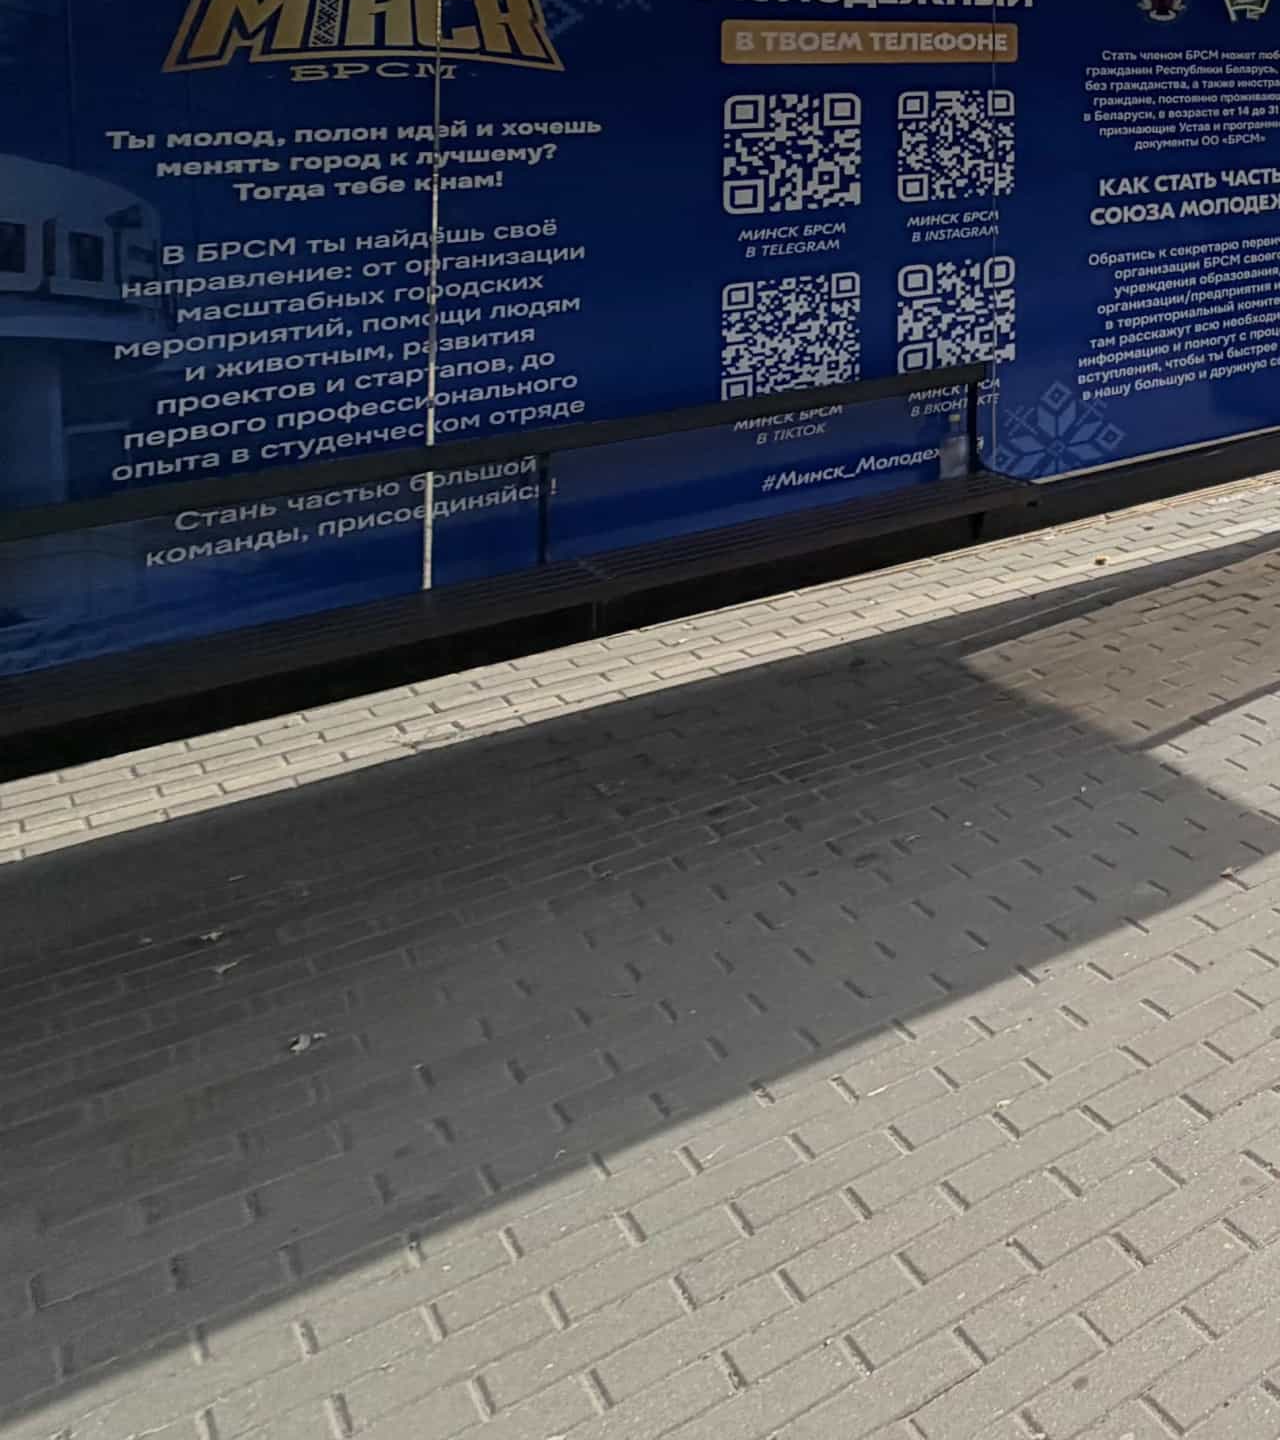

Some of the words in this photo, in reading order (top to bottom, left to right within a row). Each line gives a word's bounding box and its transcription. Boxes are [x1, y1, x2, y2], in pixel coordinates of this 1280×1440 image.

[735, 31, 754, 52] В
[760, 31, 863, 52] ТВОЕМ
[869, 31, 1008, 52] ТЕЛЕФОНЕ
[1102, 50, 1137, 61] Стать
[1139, 51, 1183, 60] членом
[1185, 50, 1218, 60] БРСМ
[290, 62, 456, 82] БРСМ
[1085, 65, 1153, 77] гражданин
[1155, 65, 1223, 77] Республики
[1085, 79, 1107, 91] без
[1110, 80, 1189, 92] гражданства,
[1094, 110, 1157, 123] Беларуси,
[1168, 108, 1220, 120] возрасте
[1222, 108, 1235, 116] от
[1238, 106, 1250, 116] 14
[1251, 107, 1265, 117] до
[1267, 105, 1279, 115] 31
[1179, 122, 1211, 133] Устав
[105, 131, 155, 149] Ты
[166, 130, 286, 148] молод,
[295, 126, 388, 143] полон
[397, 120, 467, 141] идей
[476, 123, 493, 137] и
[501, 120, 602, 136] хочешь
[1134, 137, 1199, 151] документы
[1201, 135, 1219, 146] ОО
[1222, 133, 1266, 145] «БРСМ»
[156, 158, 280, 177] менять
[289, 153, 381, 173] город
[390, 152, 408, 166] к
[416, 143, 557, 168] лучшему?
[232, 182, 326, 201] Тогда
[334, 175, 406, 196] тебе
[414, 178, 431, 191] к
[440, 171, 503, 190] нам!
[1099, 176, 1150, 197] КАК
[1154, 171, 1217, 192] СТАТЬ
[907, 213, 959, 227] МИНСК
[1089, 203, 1176, 226] СОЮЗА
[162, 245, 185, 264] В
[197, 237, 296, 263] БРСМ
[306, 238, 345, 254] ты
[356, 227, 485, 250] найдёшь
[494, 218, 558, 240] своё
[738, 225, 799, 242] МИНСК
[803, 222, 846, 237] БРСМ
[912, 232, 921, 243] В
[925, 225, 999, 241] INSTAGRAM
[745, 246, 756, 258] В
[762, 239, 840, 256] TELEGRAM
[1088, 250, 1156, 266] Обратись
[1159, 249, 1167, 258] к
[1169, 240, 1239, 259] секретарю
[121, 265, 353, 299] направление:
[362, 261, 396, 277] от
[405, 246, 585, 276] организации
[1114, 262, 1200, 280] организации
[1203, 255, 1241, 269] БРСМ
[176, 290, 384, 323] масштабных
[394, 275, 544, 303] городских
[1096, 282, 1272, 315] организации/предприятия
[1113, 277, 1197, 299] учреждения
[113, 317, 353, 360] мероприятий,
[362, 308, 481, 334] помощи
[489, 297, 581, 319] людям
[1118, 301, 1235, 330] территориальный
[1089, 337, 1116, 350] там
[1119, 325, 1192, 346] расскажут
[1194, 320, 1220, 333] всю
[185, 366, 205, 382] и
[215, 346, 394, 378] животным,
[403, 328, 535, 359] развития
[1077, 363, 1162, 385] вступления,
[1165, 355, 1205, 369] чтобы
[1208, 352, 1224, 363] ты
[1226, 342, 1278, 361] быстрее
[1078, 344, 1170, 368] информацию
[1173, 342, 1181, 352] и
[1184, 334, 1236, 351] помогут
[1239, 332, 1247, 341] с
[156, 382, 316, 417] проектов
[326, 378, 345, 393] и
[521, 352, 555, 371] до
[1082, 390, 1091, 400] в
[1094, 383, 1131, 399] нашу
[1135, 371, 1196, 390] большую
[1199, 369, 1207, 379] и
[1209, 359, 1268, 378] дружную
[908, 385, 960, 402] МИНСК
[911, 406, 920, 417] В
[923, 393, 1000, 415] ВКОНТКТЕ
[124, 417, 266, 450] первого
[276, 375, 578, 430] профессионального
[734, 413, 794, 432] МИНСК
[799, 404, 843, 421] БРСМ
[111, 452, 220, 481] опыта
[231, 448, 249, 464] в
[489, 400, 585, 425] отряде
[756, 432, 767, 445] В
[774, 422, 827, 441] TIKTOK
[174, 503, 277, 531] Стань
[287, 482, 400, 512] частью
[409, 455, 537, 492] большой
[146, 527, 309, 568] команды,
